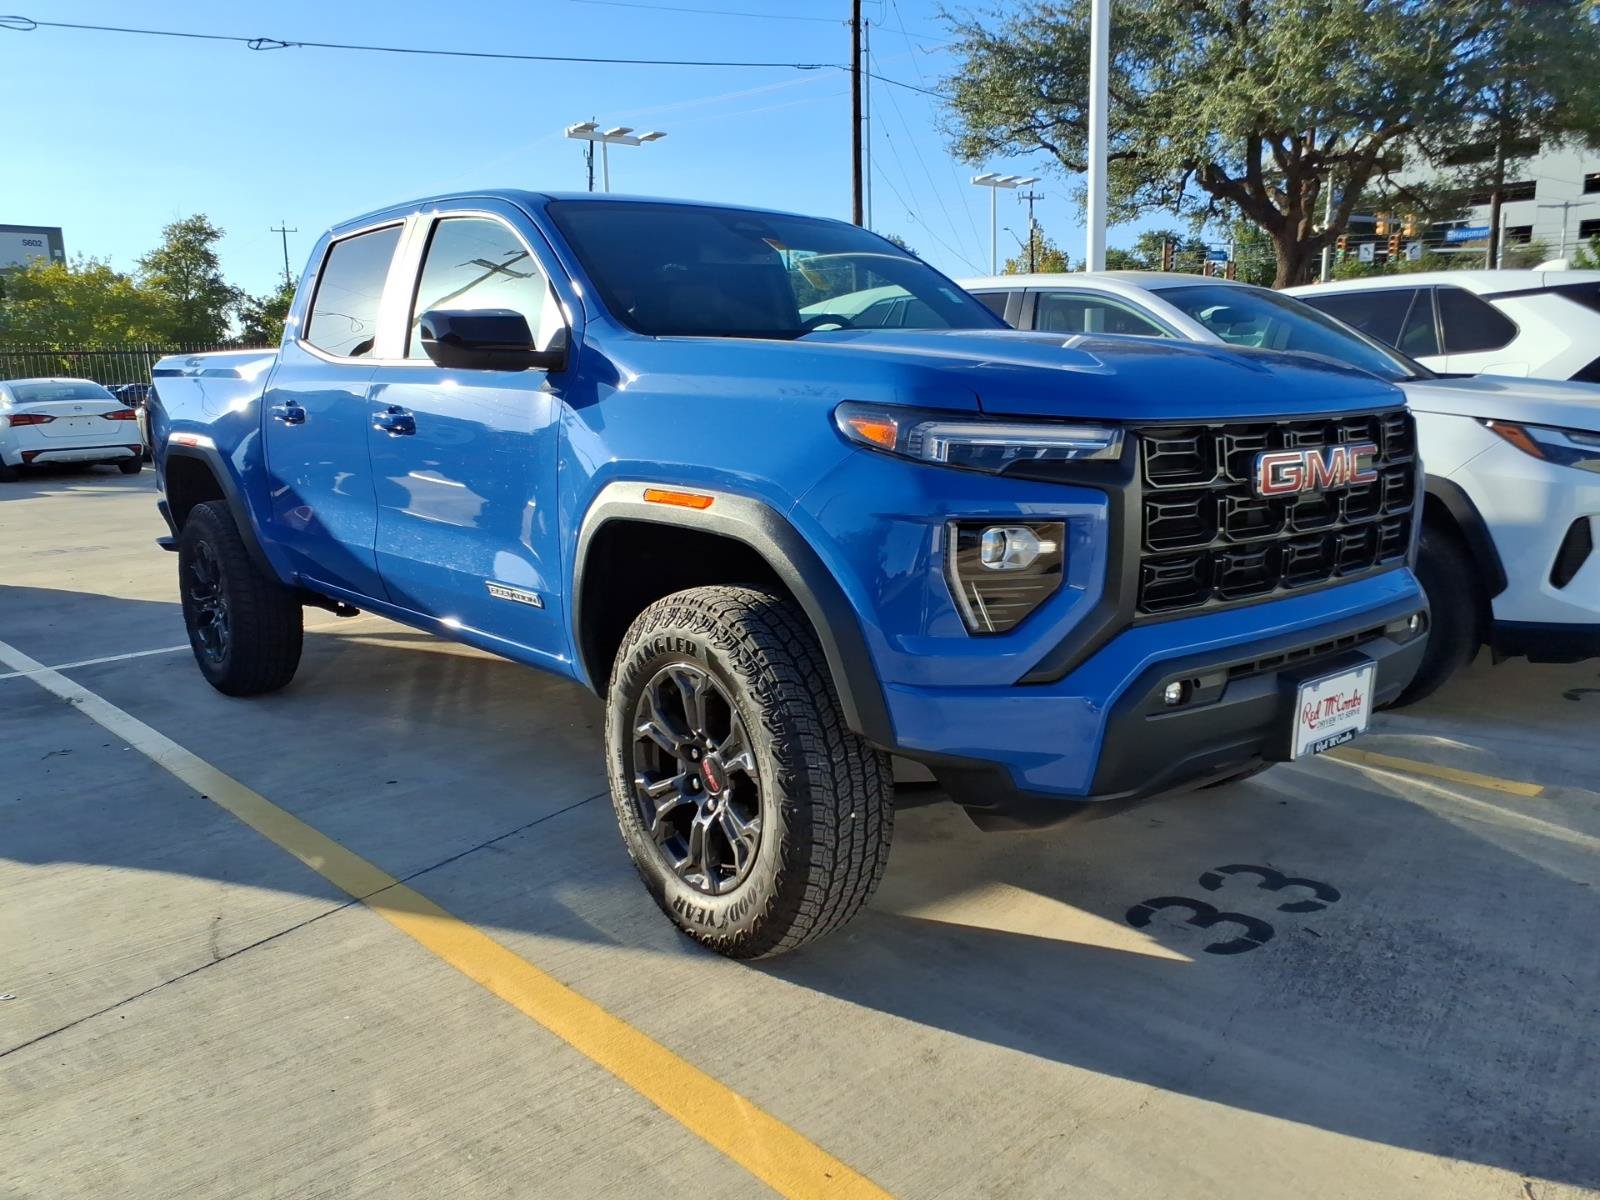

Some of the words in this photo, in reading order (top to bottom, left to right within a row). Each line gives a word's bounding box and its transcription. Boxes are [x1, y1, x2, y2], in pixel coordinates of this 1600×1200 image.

[22, 239, 43, 247] 5602
[1258, 444, 1378, 496] GMC
[1302, 700, 1322, 729] Red
[1125, 864, 1342, 955] 33
